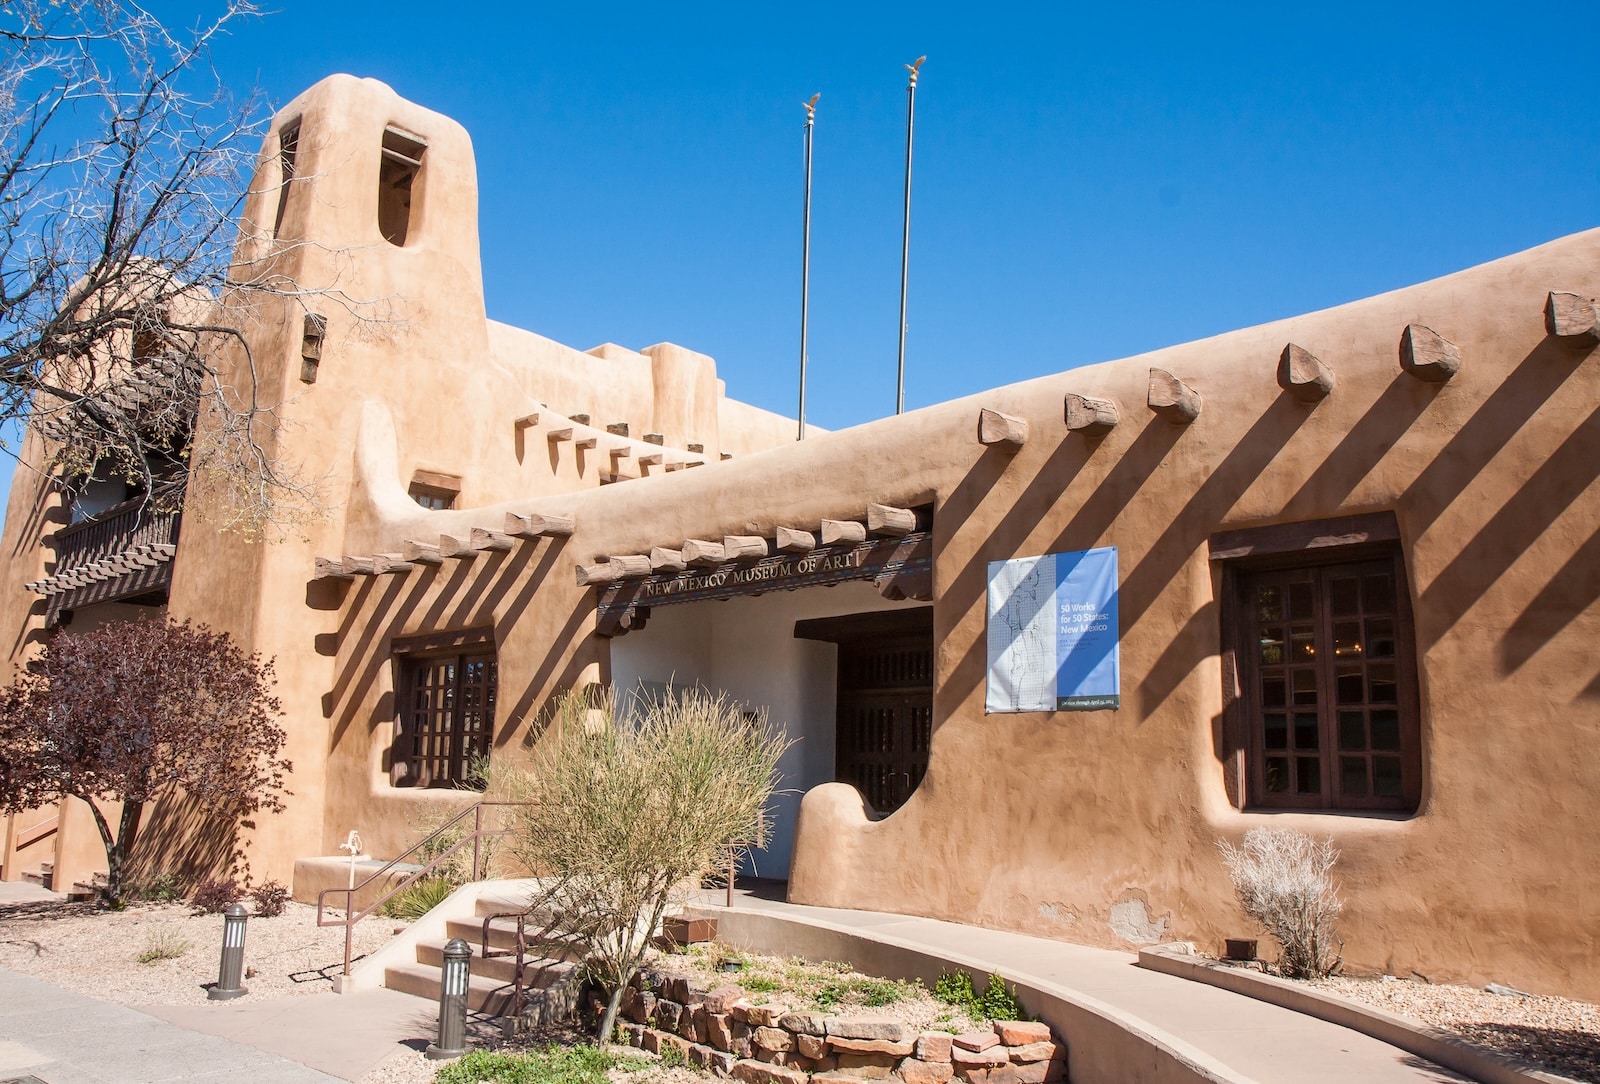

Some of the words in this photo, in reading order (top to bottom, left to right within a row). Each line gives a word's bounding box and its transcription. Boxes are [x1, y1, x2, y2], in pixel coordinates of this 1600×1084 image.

[646, 581, 673, 596] NEW
[678, 573, 726, 591] MEXICO
[733, 563, 792, 584] MUSEUM
[797, 558, 817, 573] OF
[823, 552, 854, 570] ART
[1061, 604, 1070, 613] 50
[1071, 602, 1095, 612] Works
[1061, 614, 1071, 624] for
[1073, 613, 1082, 623] 50
[1083, 612, 1109, 622] States:
[1061, 625, 1079, 634] New
[1080, 623, 1107, 633] Mexico
